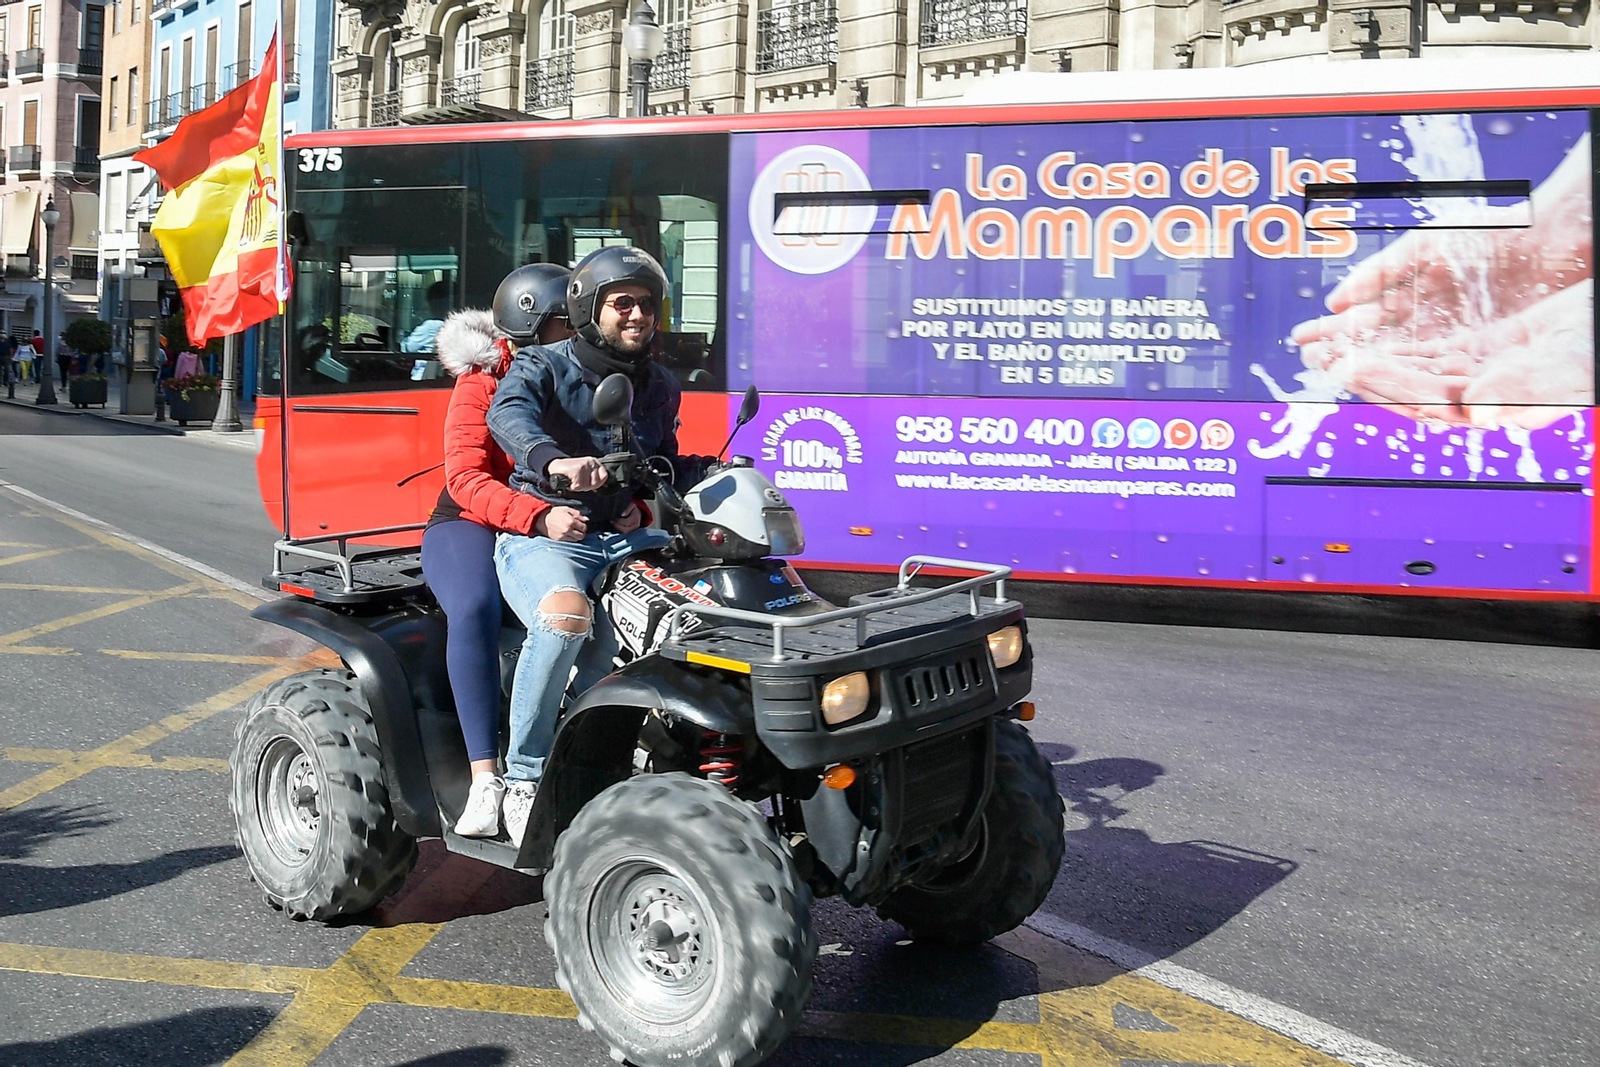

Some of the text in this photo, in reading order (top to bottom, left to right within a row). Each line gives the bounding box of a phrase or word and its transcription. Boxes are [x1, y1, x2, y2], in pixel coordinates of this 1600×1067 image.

[298, 147, 343, 173] 375
[965, 147, 1357, 200] La Casa de las
[884, 188, 1358, 279] Mamparas
[912, 295, 1209, 317] SUSTITUIMOS SU BAÑERA
[902, 318, 1222, 341] POR PLATO EN UN SOLO DÍA
[932, 340, 1187, 363] Y EL BAÑO COMPLETO
[1001, 363, 1114, 385] EN 5 DÍAS
[895, 415, 1085, 446] 958 560 400
[780, 439, 843, 469] 100%
[895, 449, 968, 465] AUTOVÍA
[969, 451, 1054, 468] GRANADA
[1065, 452, 1113, 469] JAÉN
[895, 472, 1236, 498] www.lacasadelasmamparas.com
